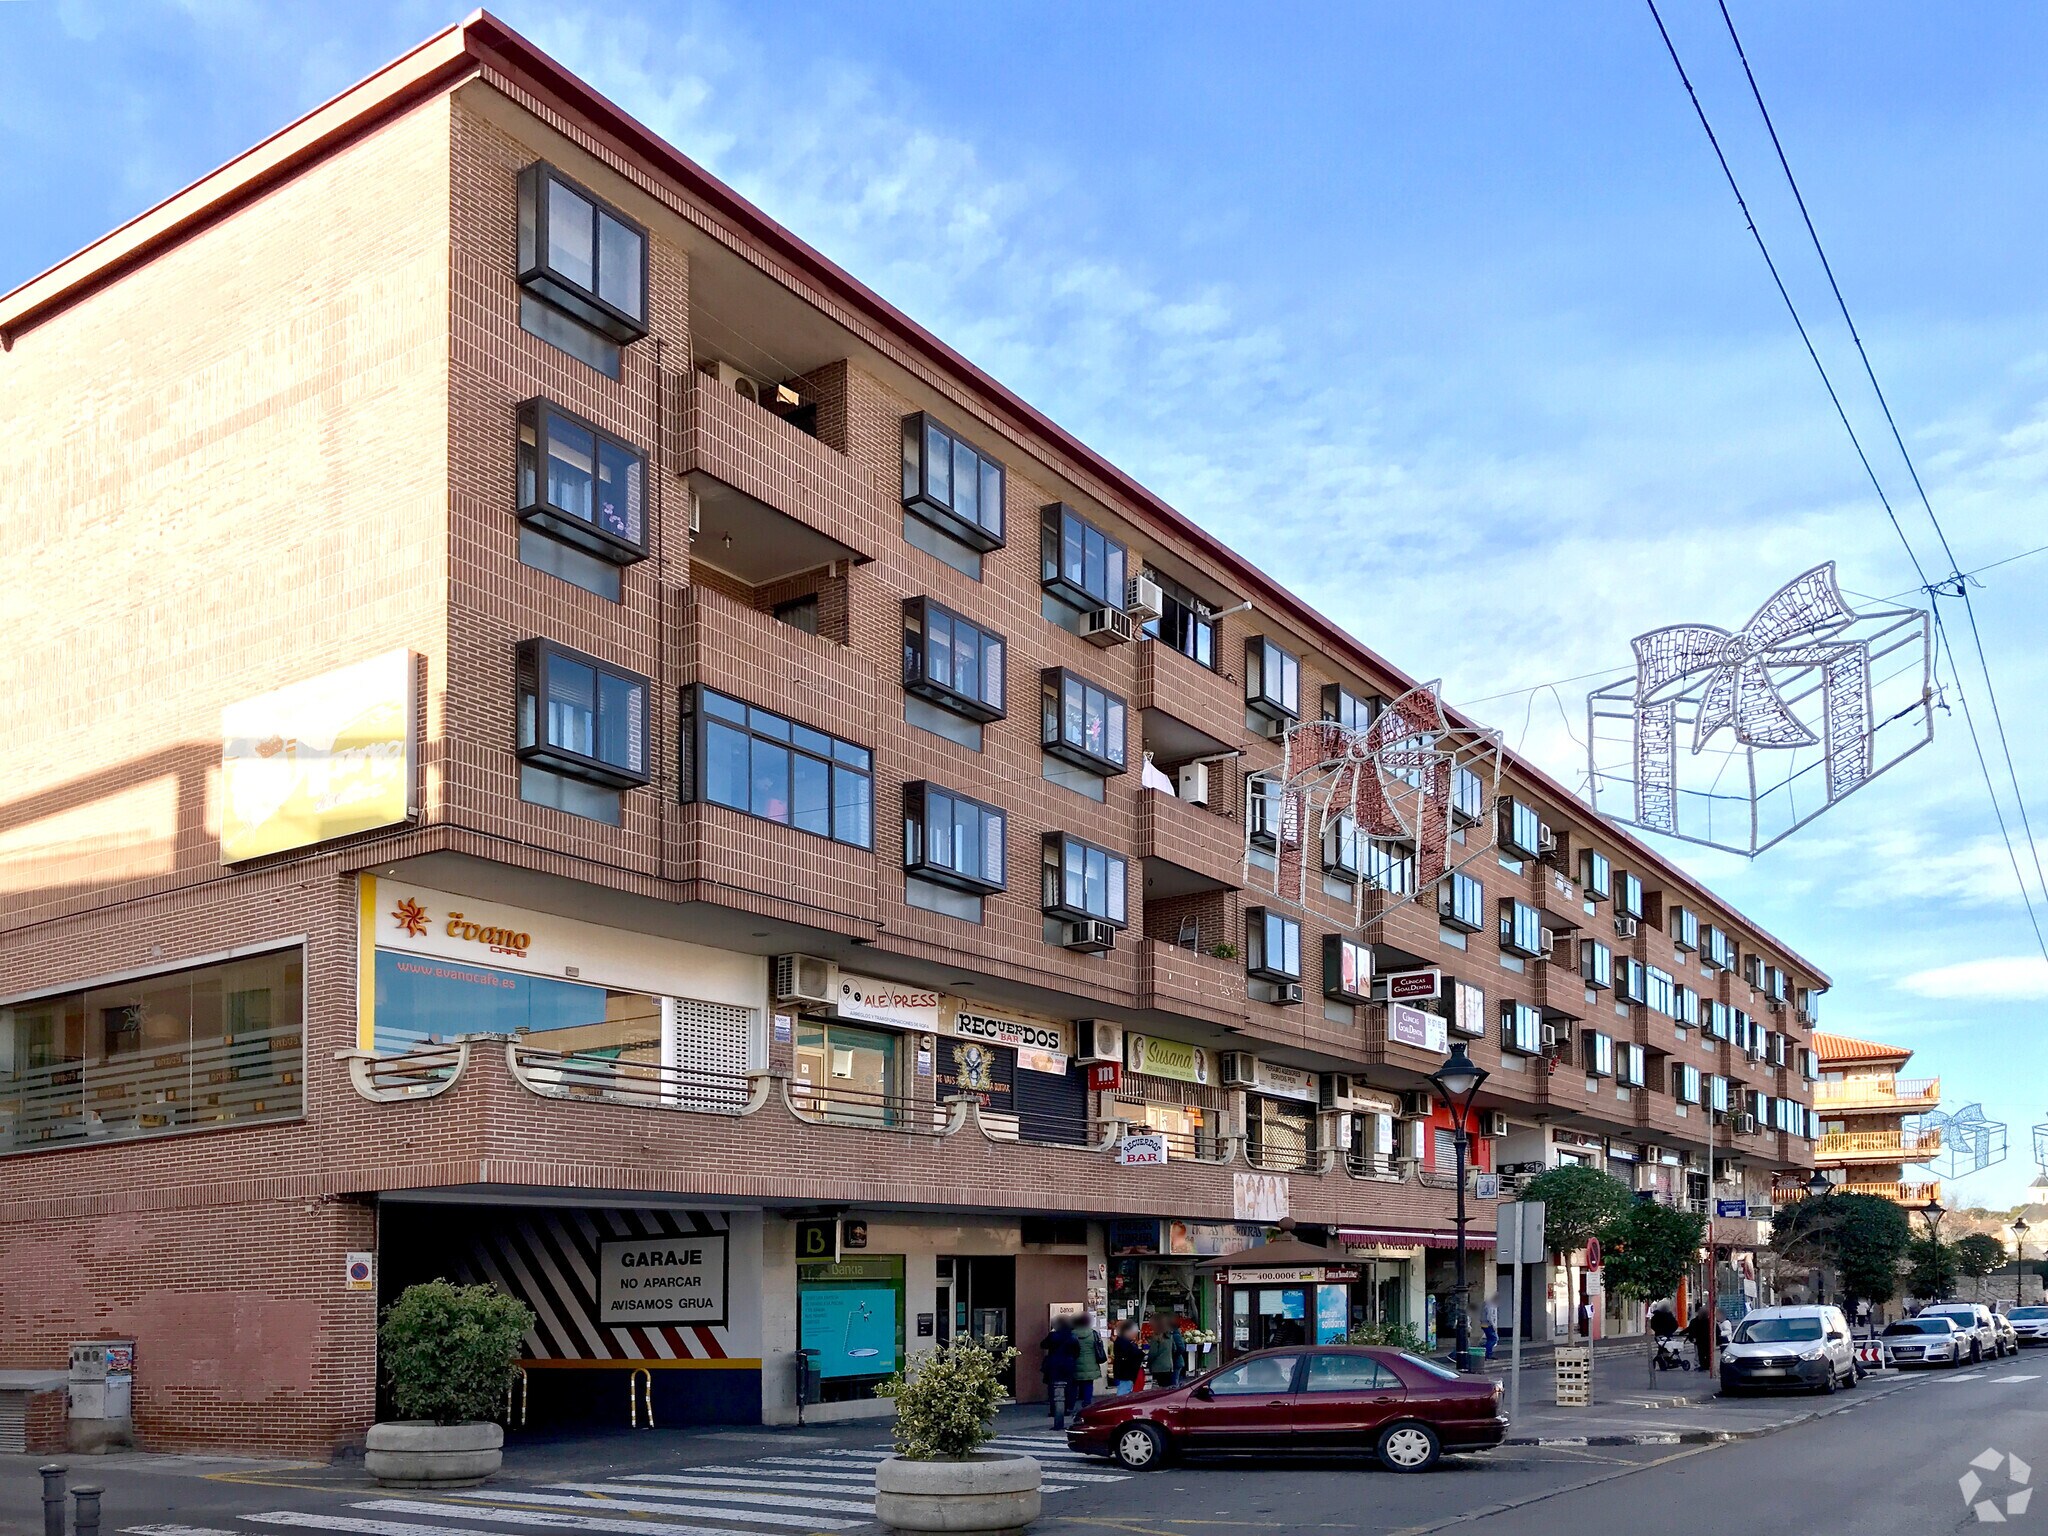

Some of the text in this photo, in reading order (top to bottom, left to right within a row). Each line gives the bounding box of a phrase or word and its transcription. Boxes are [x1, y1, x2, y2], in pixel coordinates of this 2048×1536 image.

[396, 961, 516, 989] www.evanocafe.es
[864, 985, 937, 1010] ALEXPRESS
[958, 1013, 1059, 1049] RECUERDOS
[1000, 1032, 1019, 1043] BAR
[1146, 1041, 1193, 1069] Susana
[1123, 1138, 1162, 1153] RECUERDOS
[1126, 1153, 1158, 1163] BAR
[806, 1227, 826, 1253] B
[621, 1249, 702, 1268] GARAJE
[831, 1263, 864, 1275] Bankia
[1231, 1272, 1242, 1281] 75
[1256, 1272, 1296, 1281] 400.000€
[621, 1276, 702, 1289] NO APARCAR
[610, 1297, 714, 1311] AVISAMOS GRUA
